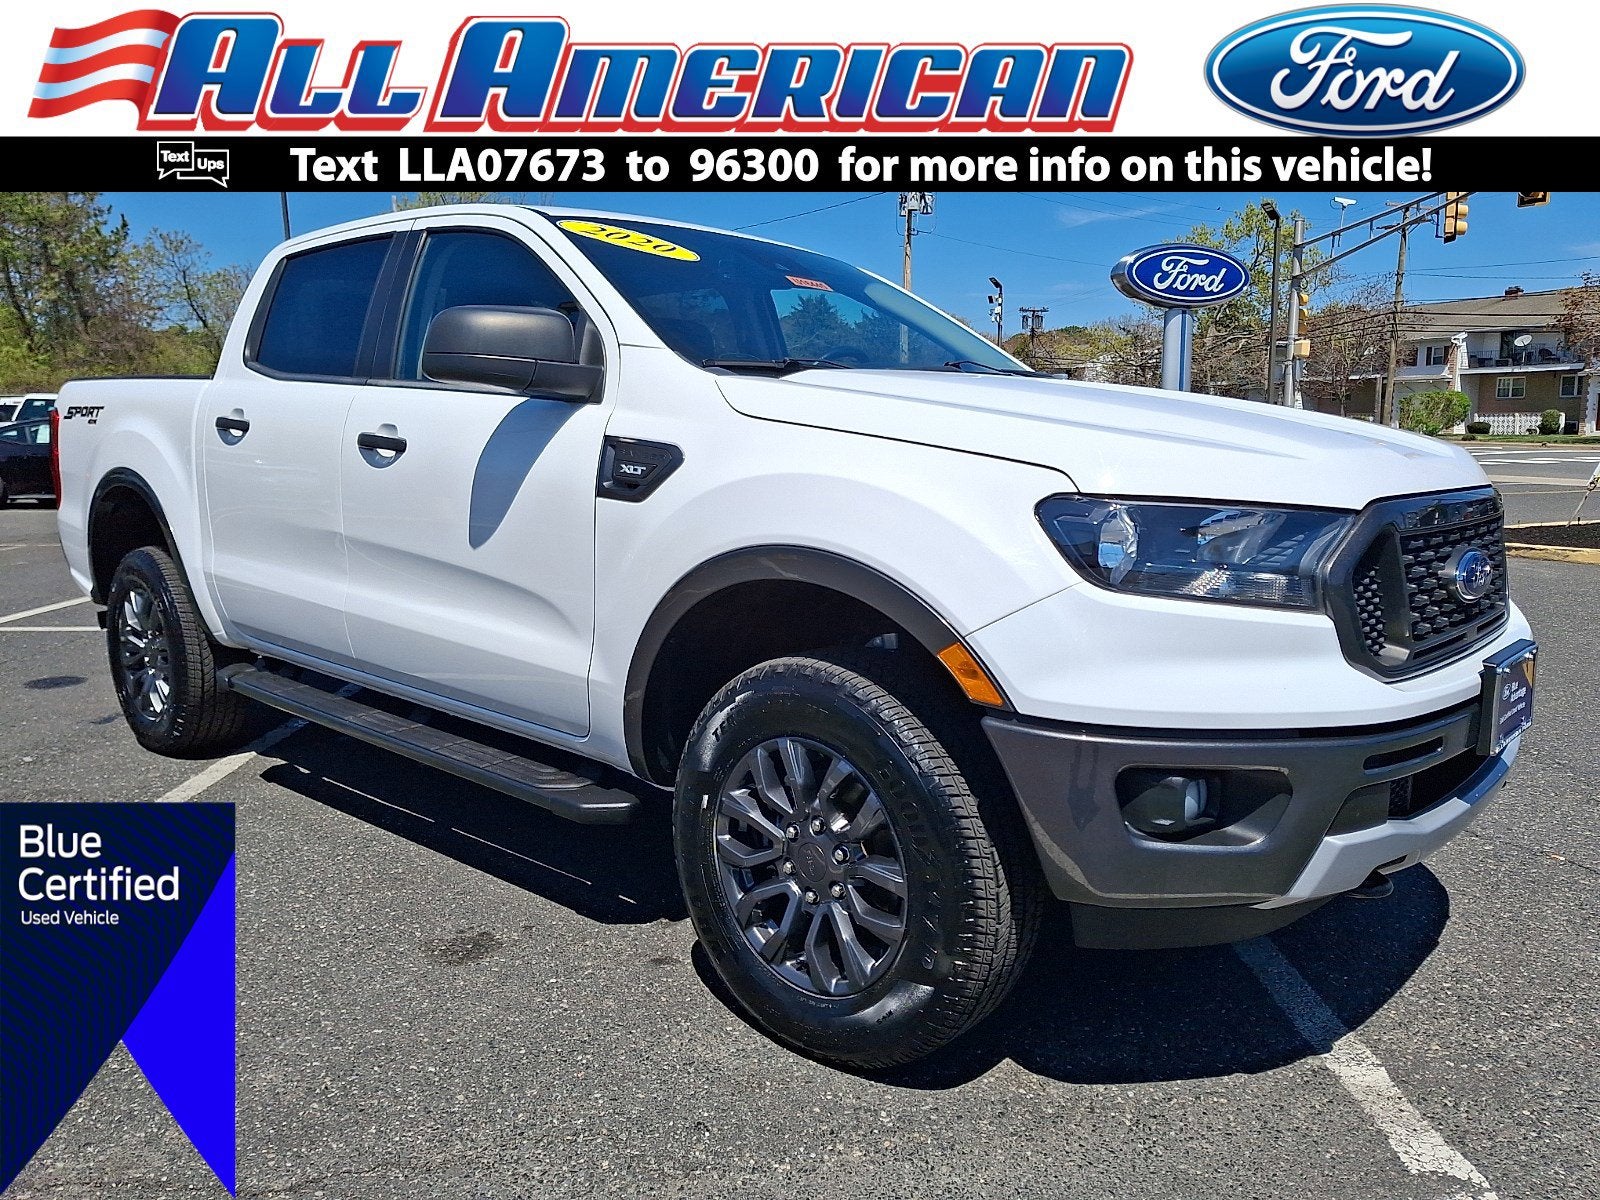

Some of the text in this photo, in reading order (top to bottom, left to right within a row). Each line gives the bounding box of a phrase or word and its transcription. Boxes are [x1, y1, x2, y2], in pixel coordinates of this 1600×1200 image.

[579, 226, 677, 252] 2020
[1153, 255, 1227, 292] Ford
[63, 406, 105, 420] SPORT
[620, 464, 647, 475] XLT
